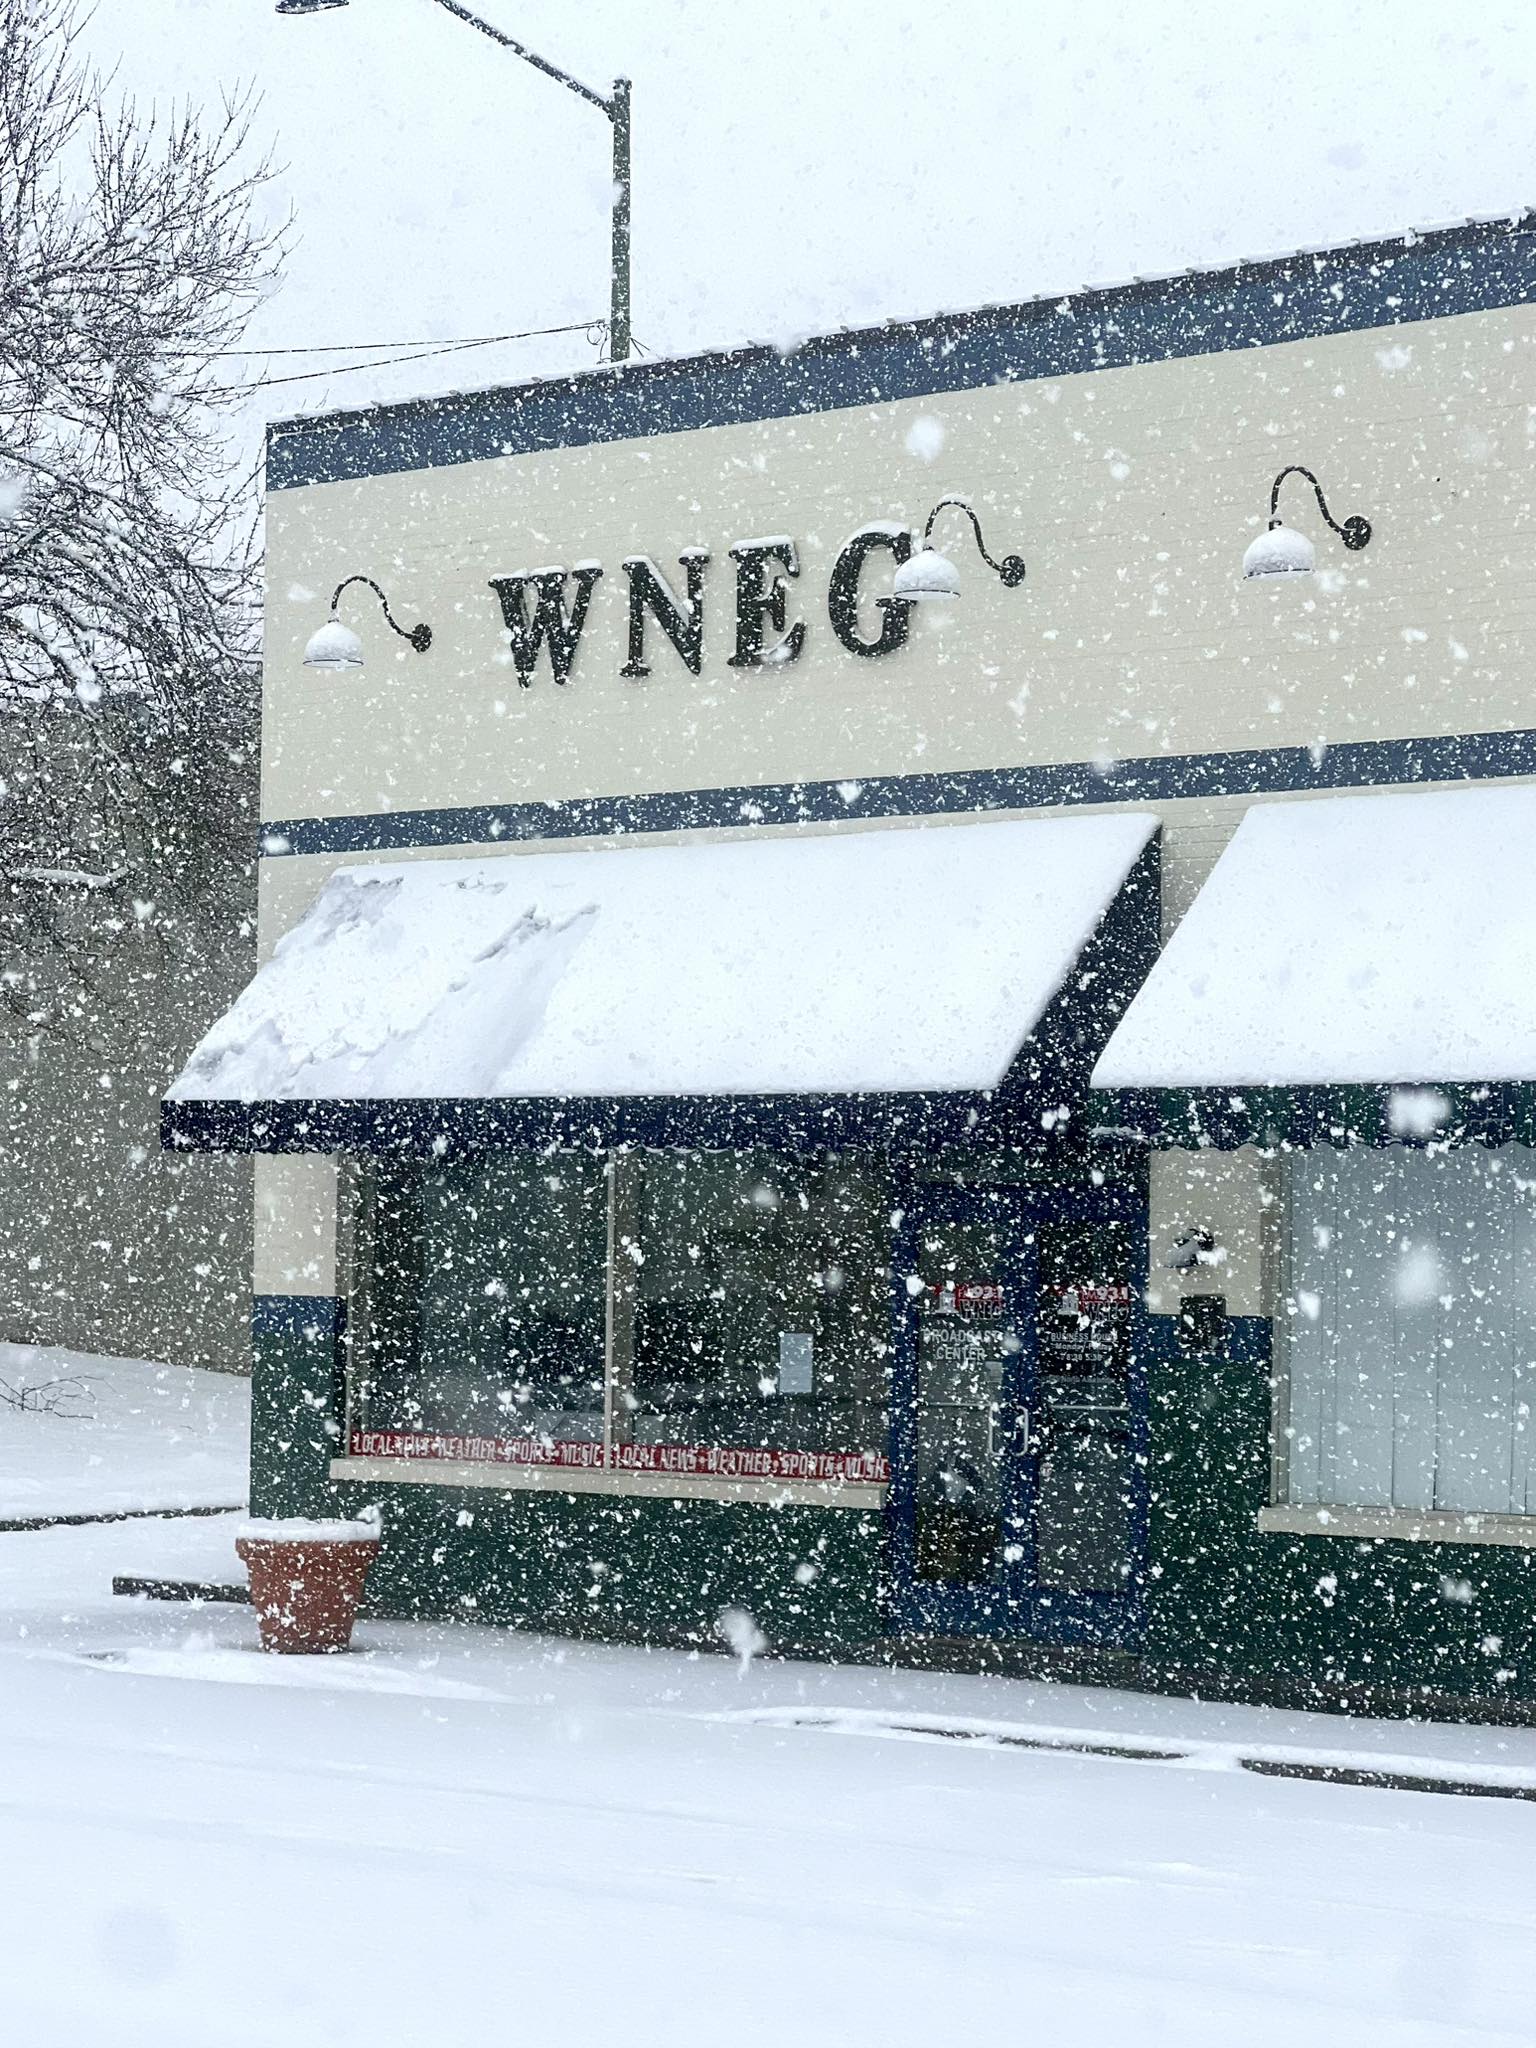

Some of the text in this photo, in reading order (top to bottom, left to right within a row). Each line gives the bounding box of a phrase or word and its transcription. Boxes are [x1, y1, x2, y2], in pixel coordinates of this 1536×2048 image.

[488, 521, 917, 689] WNEG
[1096, 1286, 1129, 1300] 93.1
[936, 1346, 985, 1360] CENTER
[354, 1433, 394, 1455] LOCAL
[435, 1436, 497, 1460] WEATHER
[503, 1440, 552, 1462] SPORTS
[561, 1443, 602, 1466] MUSIC
[616, 1443, 889, 1479] LOCAL NEWS WEATHER SPORTS MUSIC
